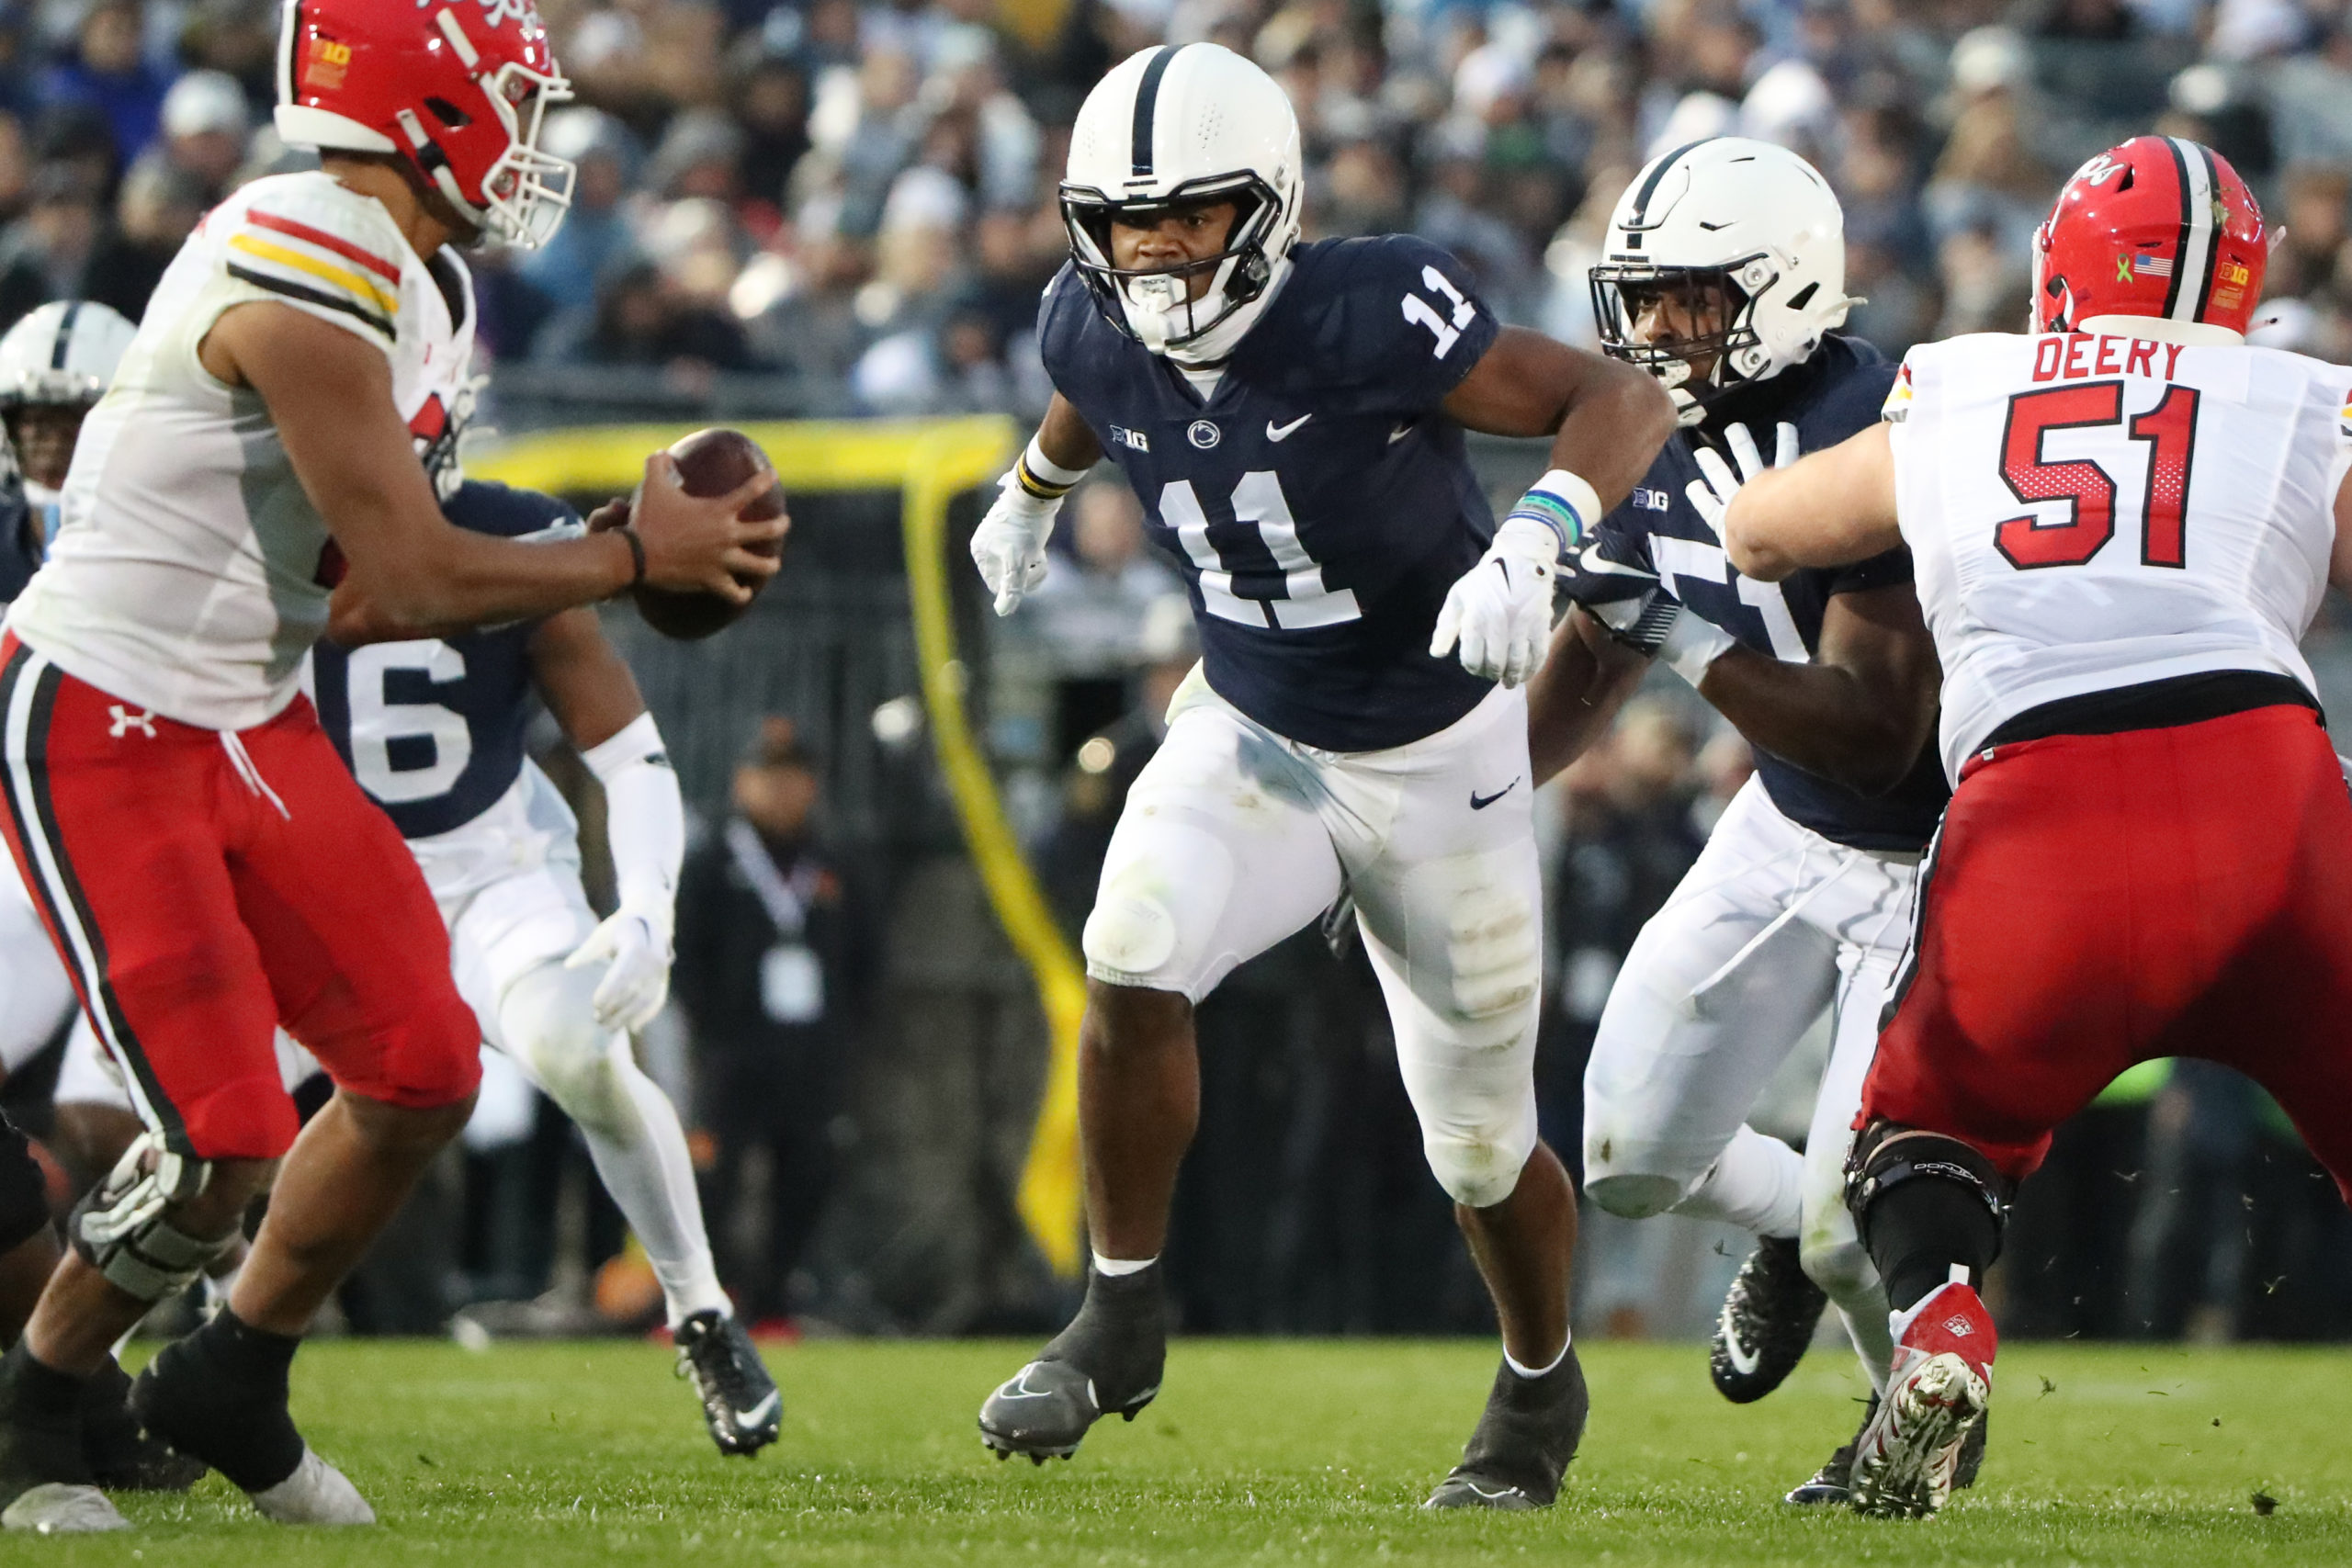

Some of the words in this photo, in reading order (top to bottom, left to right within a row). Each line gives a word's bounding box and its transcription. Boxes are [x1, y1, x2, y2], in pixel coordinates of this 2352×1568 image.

[1401, 265, 1476, 359] 11
[2031, 333, 2187, 382] DEERY
[1159, 470, 1363, 629] 11
[1993, 379, 2201, 570] 51
[346, 638, 472, 804] 6
